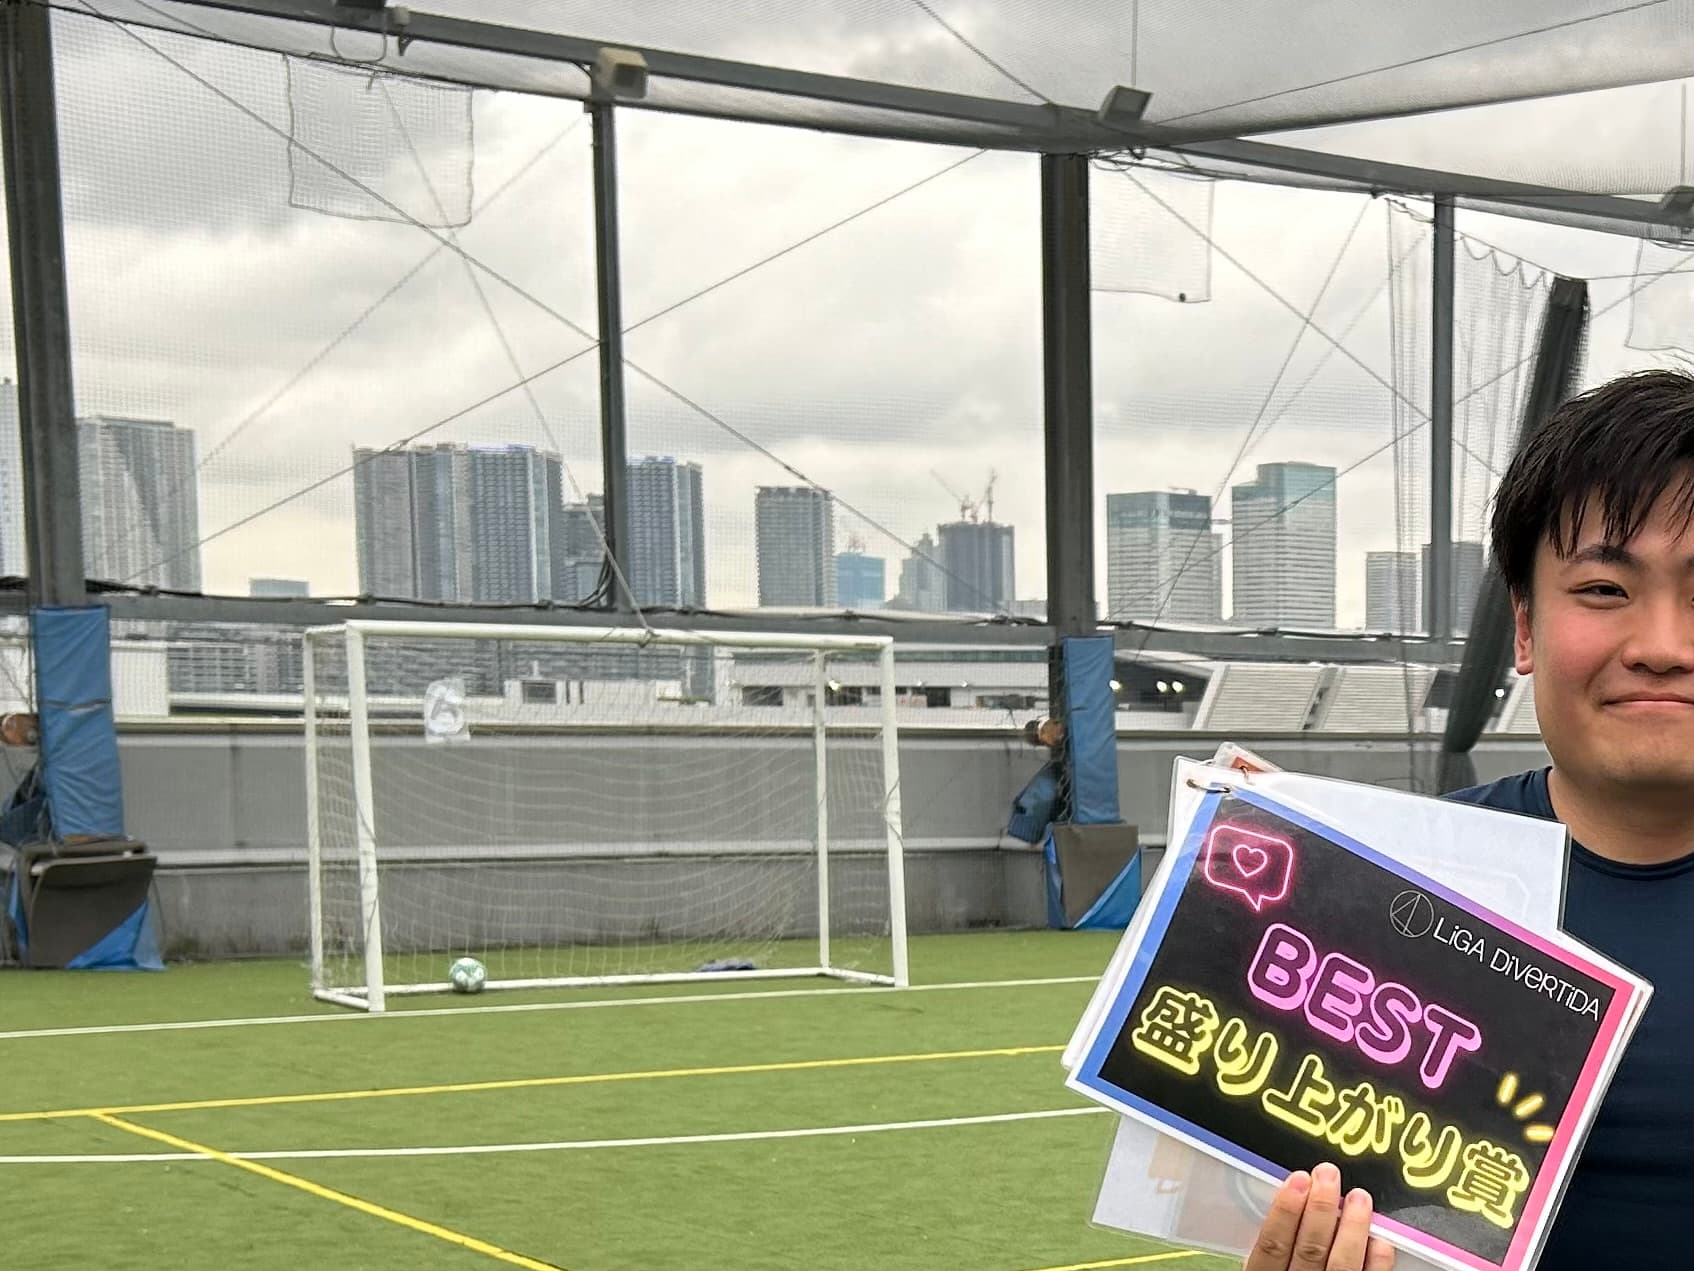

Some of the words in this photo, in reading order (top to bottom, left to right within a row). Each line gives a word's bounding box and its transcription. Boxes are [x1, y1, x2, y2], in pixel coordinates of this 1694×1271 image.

[1132, 985, 1531, 1230] 盛り上がり賞
[1247, 922, 1482, 1089] BEST
